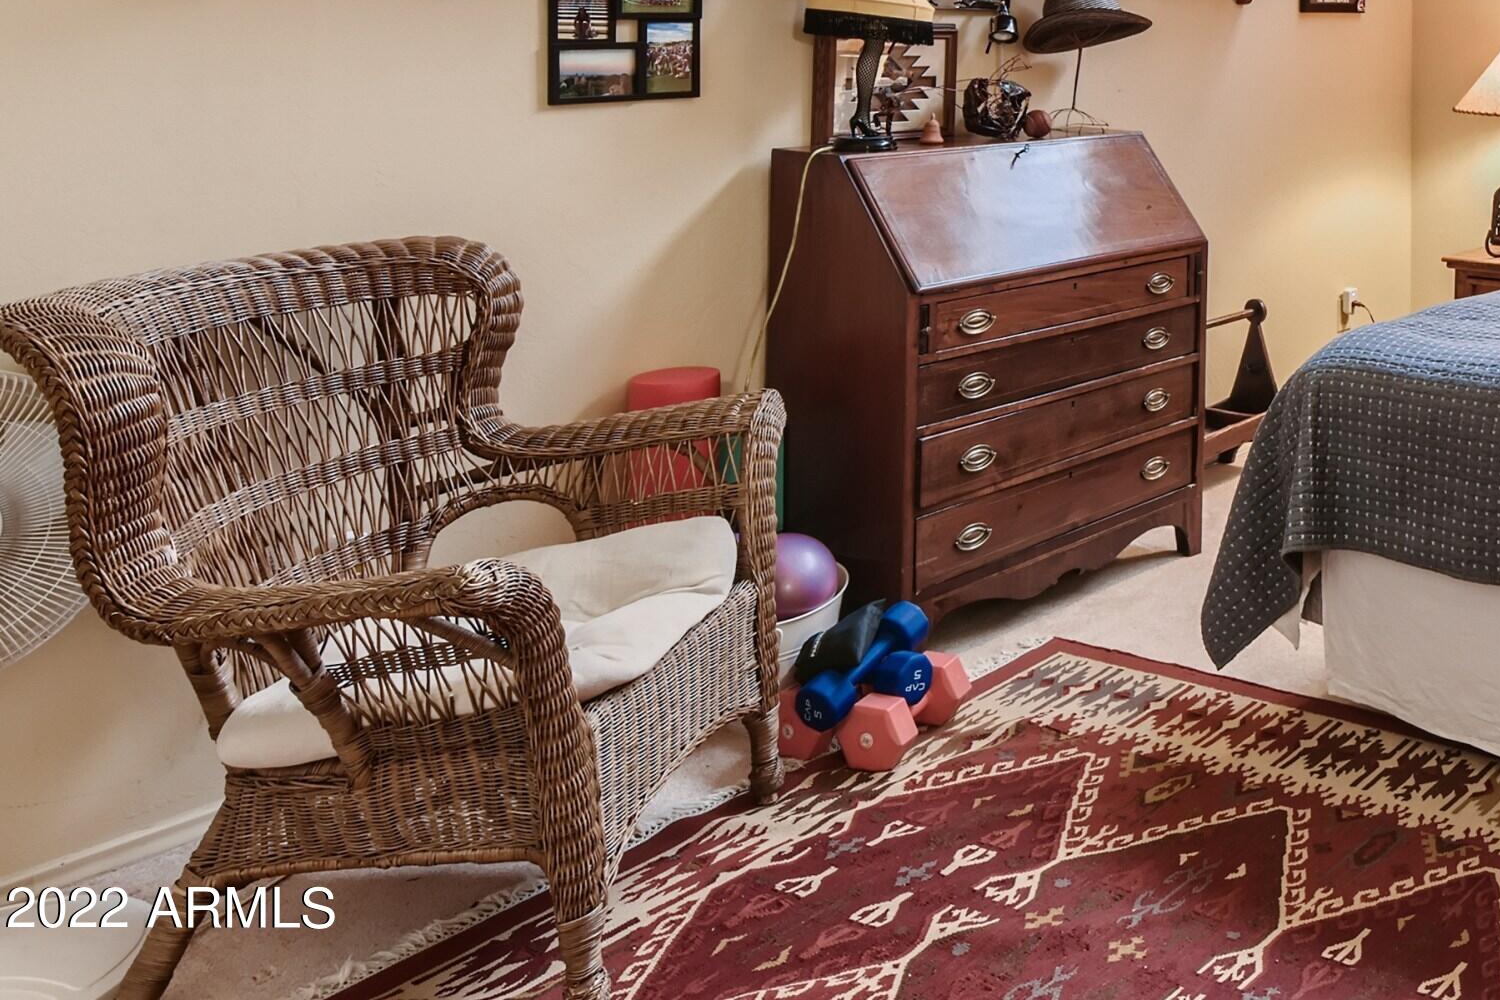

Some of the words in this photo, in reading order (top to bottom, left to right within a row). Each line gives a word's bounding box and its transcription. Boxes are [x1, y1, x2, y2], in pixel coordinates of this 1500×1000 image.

[913, 669, 922, 680] 5
[905, 682, 926, 693] CAP
[804, 698, 813, 721] CAP
[814, 710, 823, 720] 5
